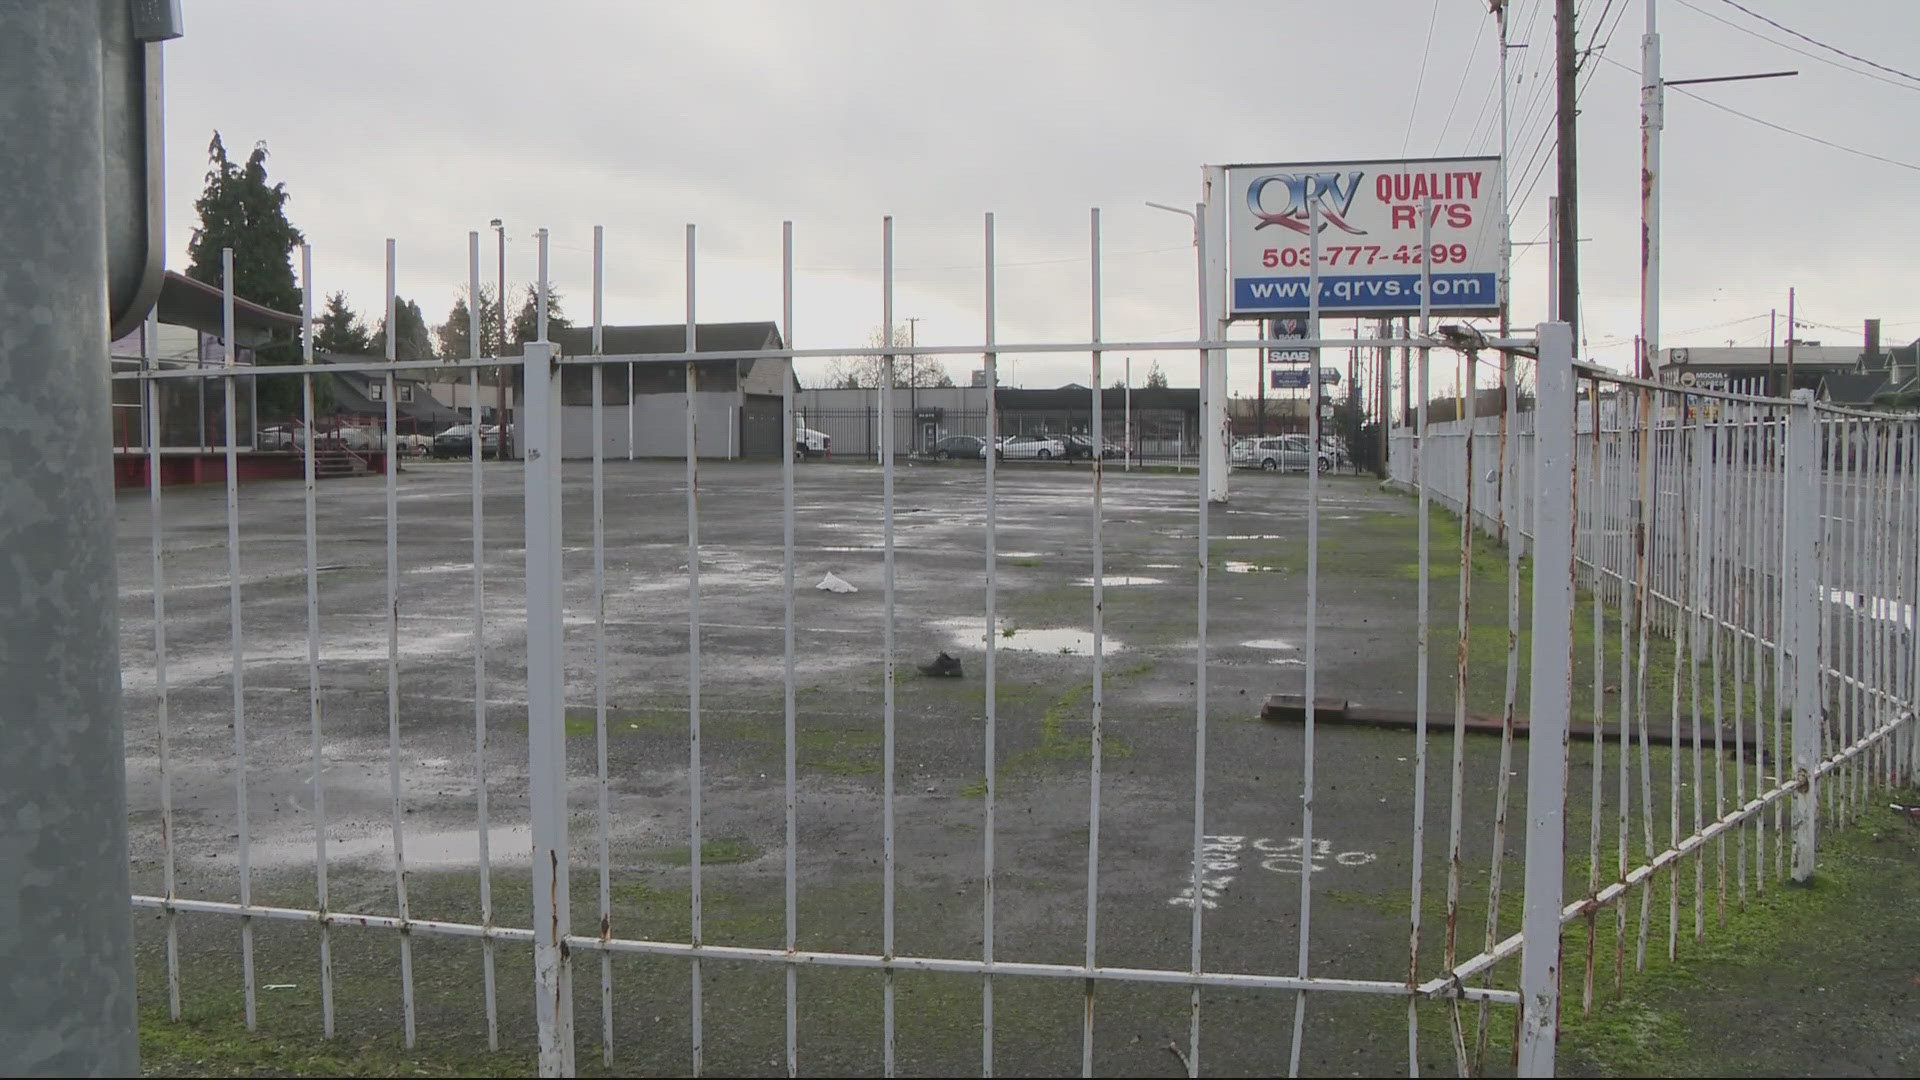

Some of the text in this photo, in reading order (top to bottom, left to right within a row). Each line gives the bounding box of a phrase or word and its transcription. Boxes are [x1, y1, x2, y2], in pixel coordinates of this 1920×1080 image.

[1376, 172, 1482, 204] QUALITY
[1247, 171, 1368, 236] QRV
[1262, 243, 1468, 268] 503-777-4299
[1270, 351, 1309, 362] SAAB
